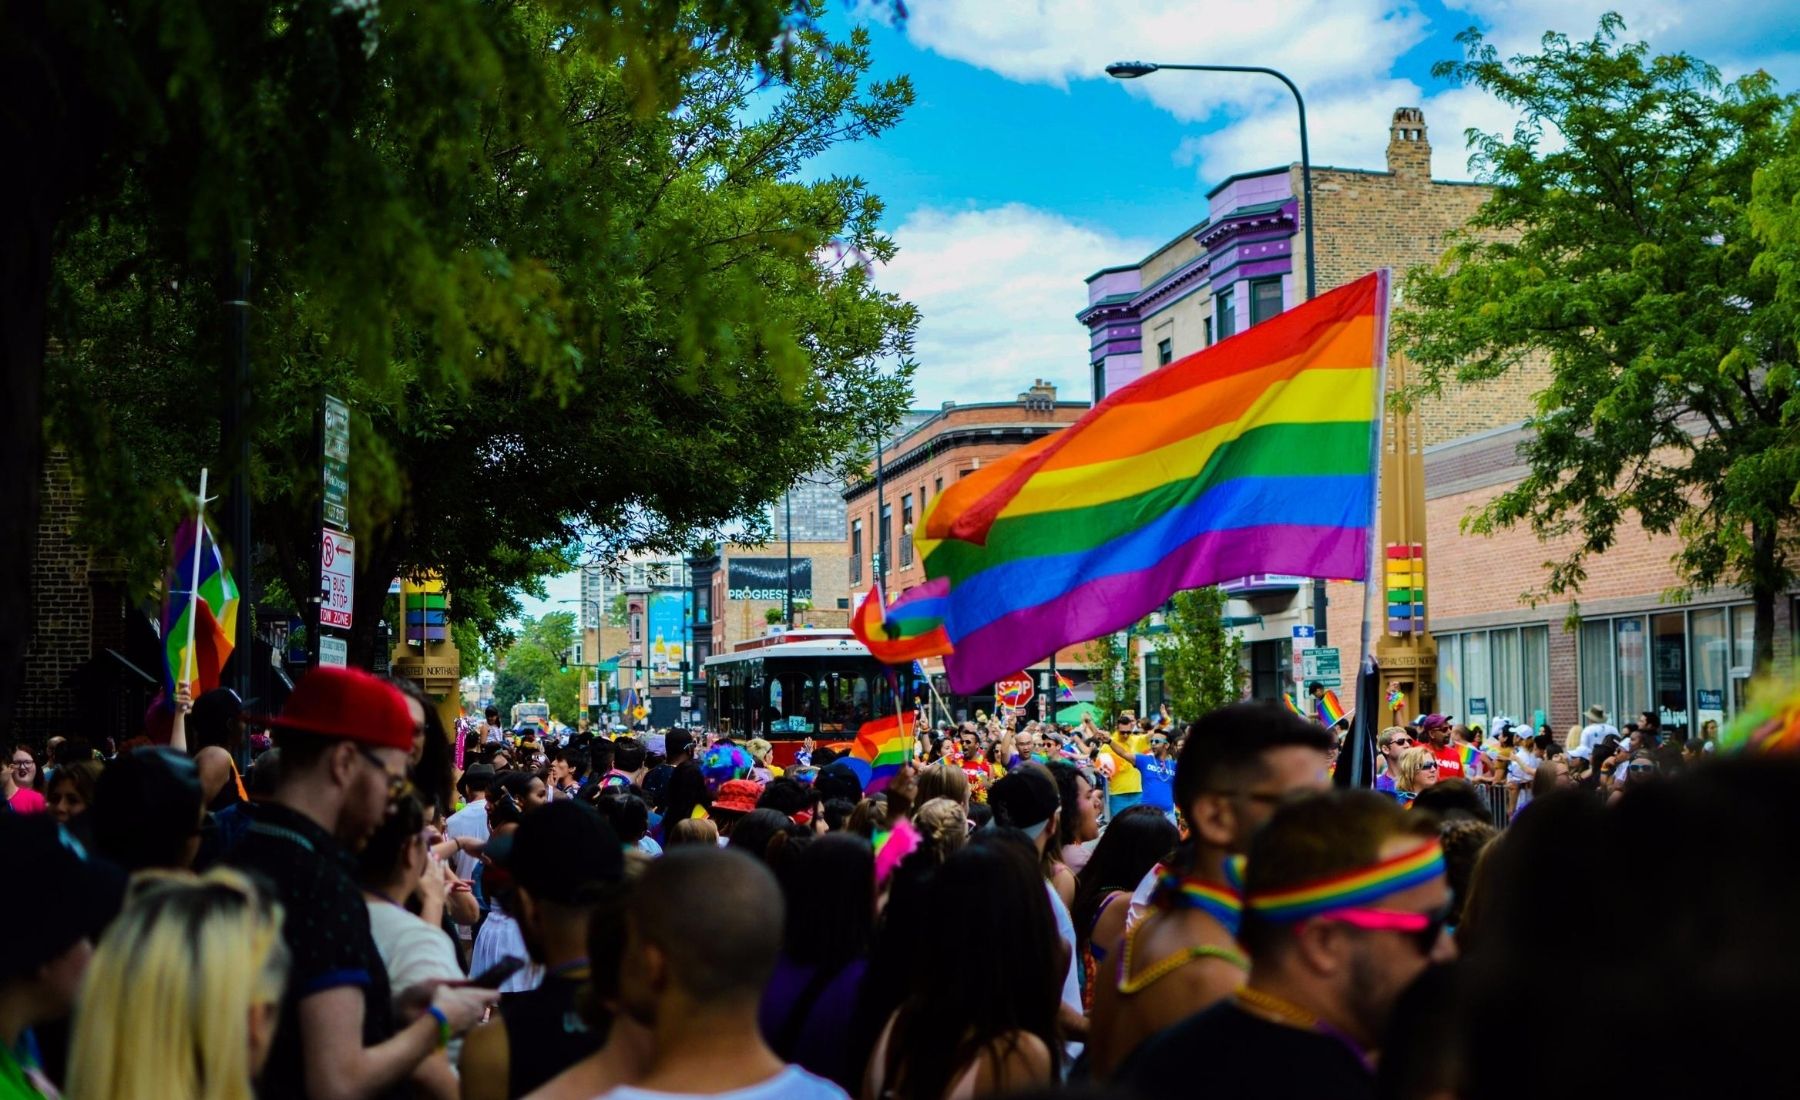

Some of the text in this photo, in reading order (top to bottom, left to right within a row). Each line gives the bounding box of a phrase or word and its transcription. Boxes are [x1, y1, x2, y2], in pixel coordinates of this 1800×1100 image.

[333, 577, 345, 592] BUS
[332, 593, 348, 608] STOP
[728, 589, 783, 600] PROGRES
[333, 612, 349, 626] ZONE
[999, 681, 1031, 695] STOP
